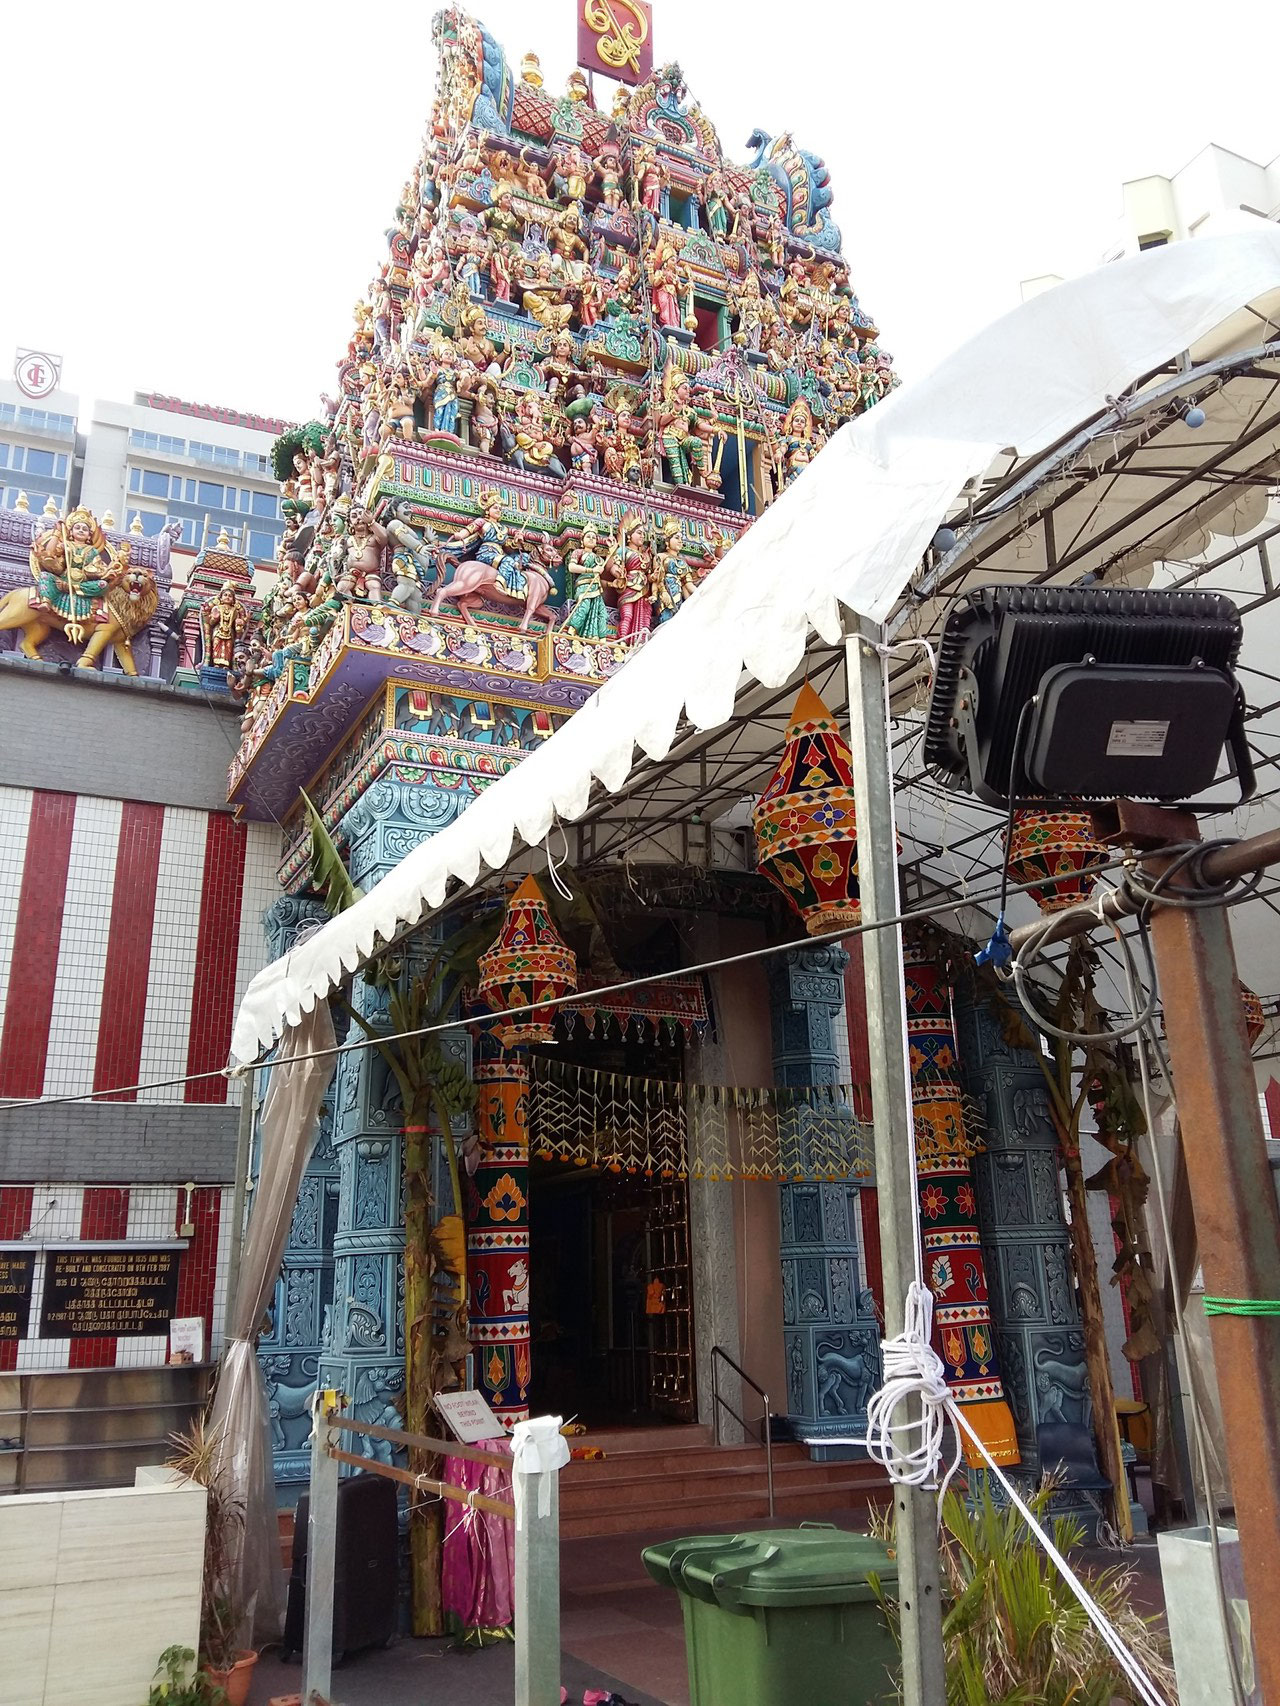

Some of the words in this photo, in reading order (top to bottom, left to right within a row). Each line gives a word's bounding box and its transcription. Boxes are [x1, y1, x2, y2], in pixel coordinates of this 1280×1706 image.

[148, 391, 240, 425] GRAND
[57, 1255, 68, 1263] THIS
[69, 1255, 89, 1263] TEMPLE
[91, 1255, 102, 1263] WAS
[103, 1255, 126, 1263] FOUNDED
[128, 1255, 134, 1263] IN
[135, 1255, 147, 1263] 1835
[148, 1255, 158, 1263] AND
[160, 1255, 171, 1263] WAS
[12, 1261, 26, 1270] MADE
[82, 1264, 92, 1272] AND
[92, 1264, 126, 1272] CONSECRATED
[127, 1264, 134, 1272] ON
[135, 1264, 146, 1272] 8TH
[146, 1264, 158, 1272] FEB
[158, 1264, 170, 1272] 1987
